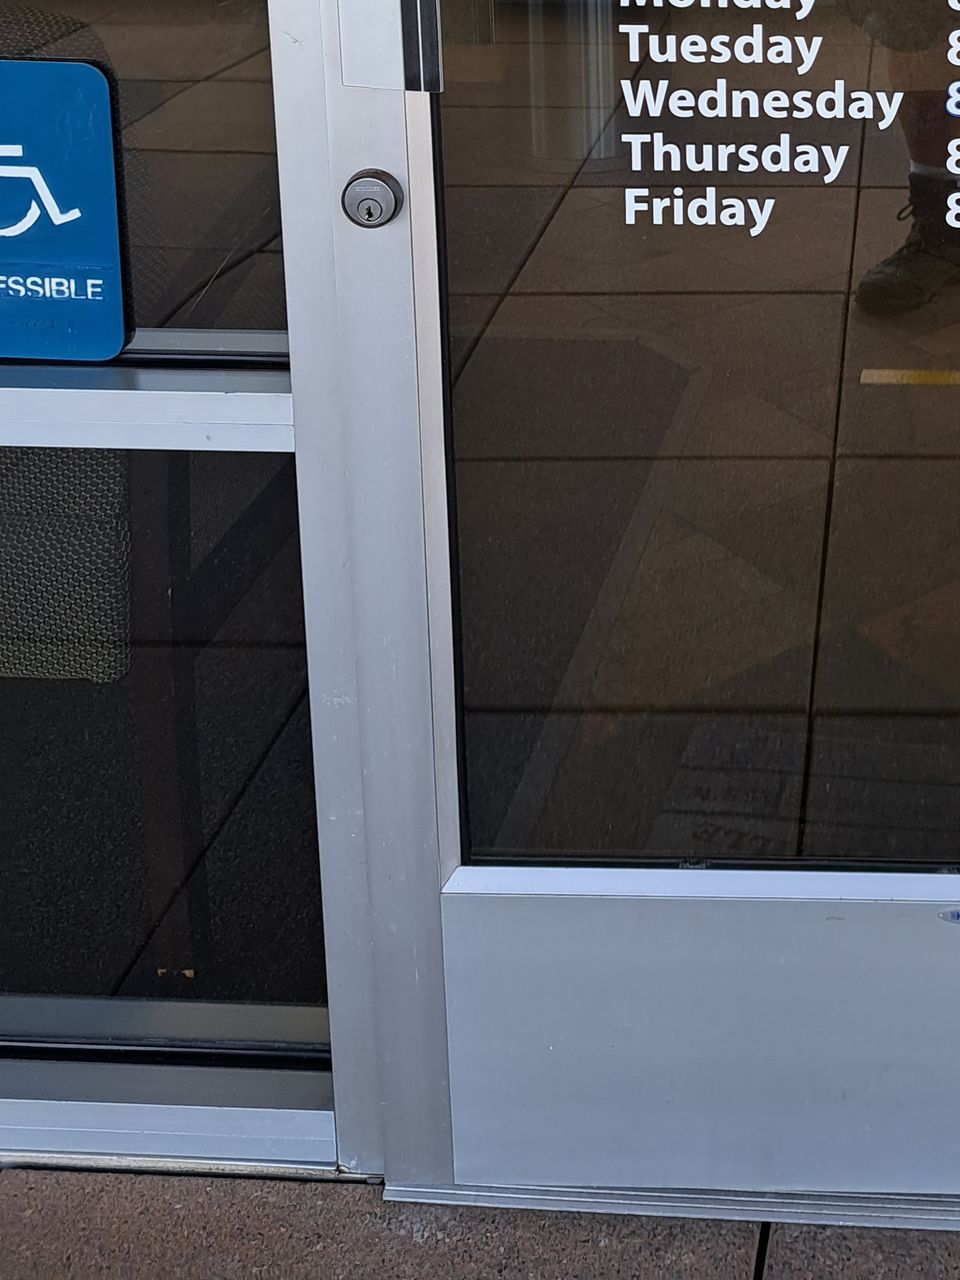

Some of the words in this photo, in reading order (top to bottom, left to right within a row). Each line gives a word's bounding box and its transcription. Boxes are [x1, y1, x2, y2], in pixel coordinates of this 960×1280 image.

[618, 23, 824, 76] Tuesday
[620, 78, 905, 131] Wednesday
[621, 132, 850, 184] Thursday
[624, 186, 776, 238] Friday
